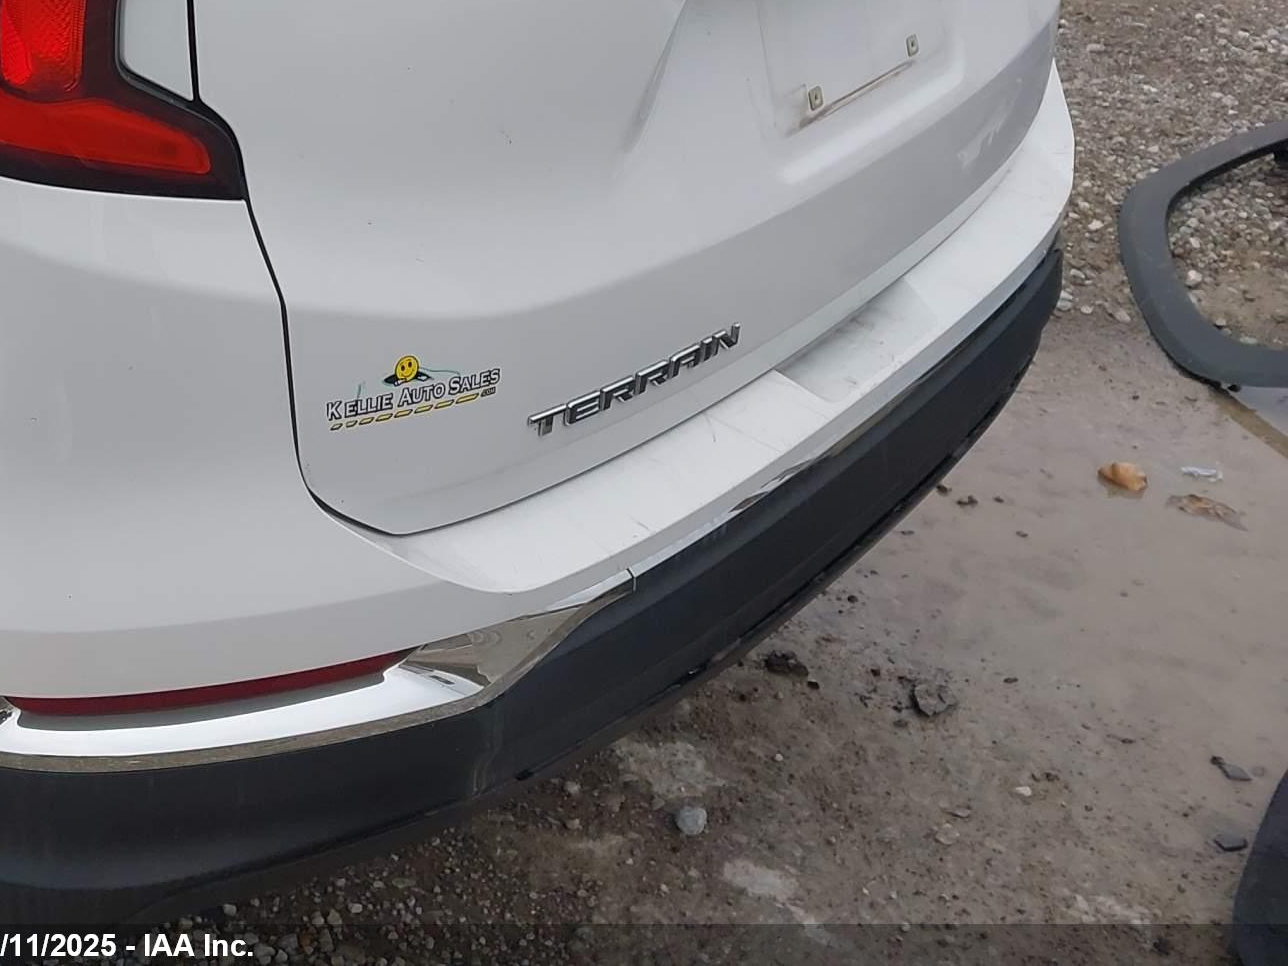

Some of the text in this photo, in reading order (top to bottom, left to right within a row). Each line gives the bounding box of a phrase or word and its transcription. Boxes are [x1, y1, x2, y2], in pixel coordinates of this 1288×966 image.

[326, 368, 501, 422] KELLIE AUTO SALES
[527, 321, 740, 436] TERRAIN
